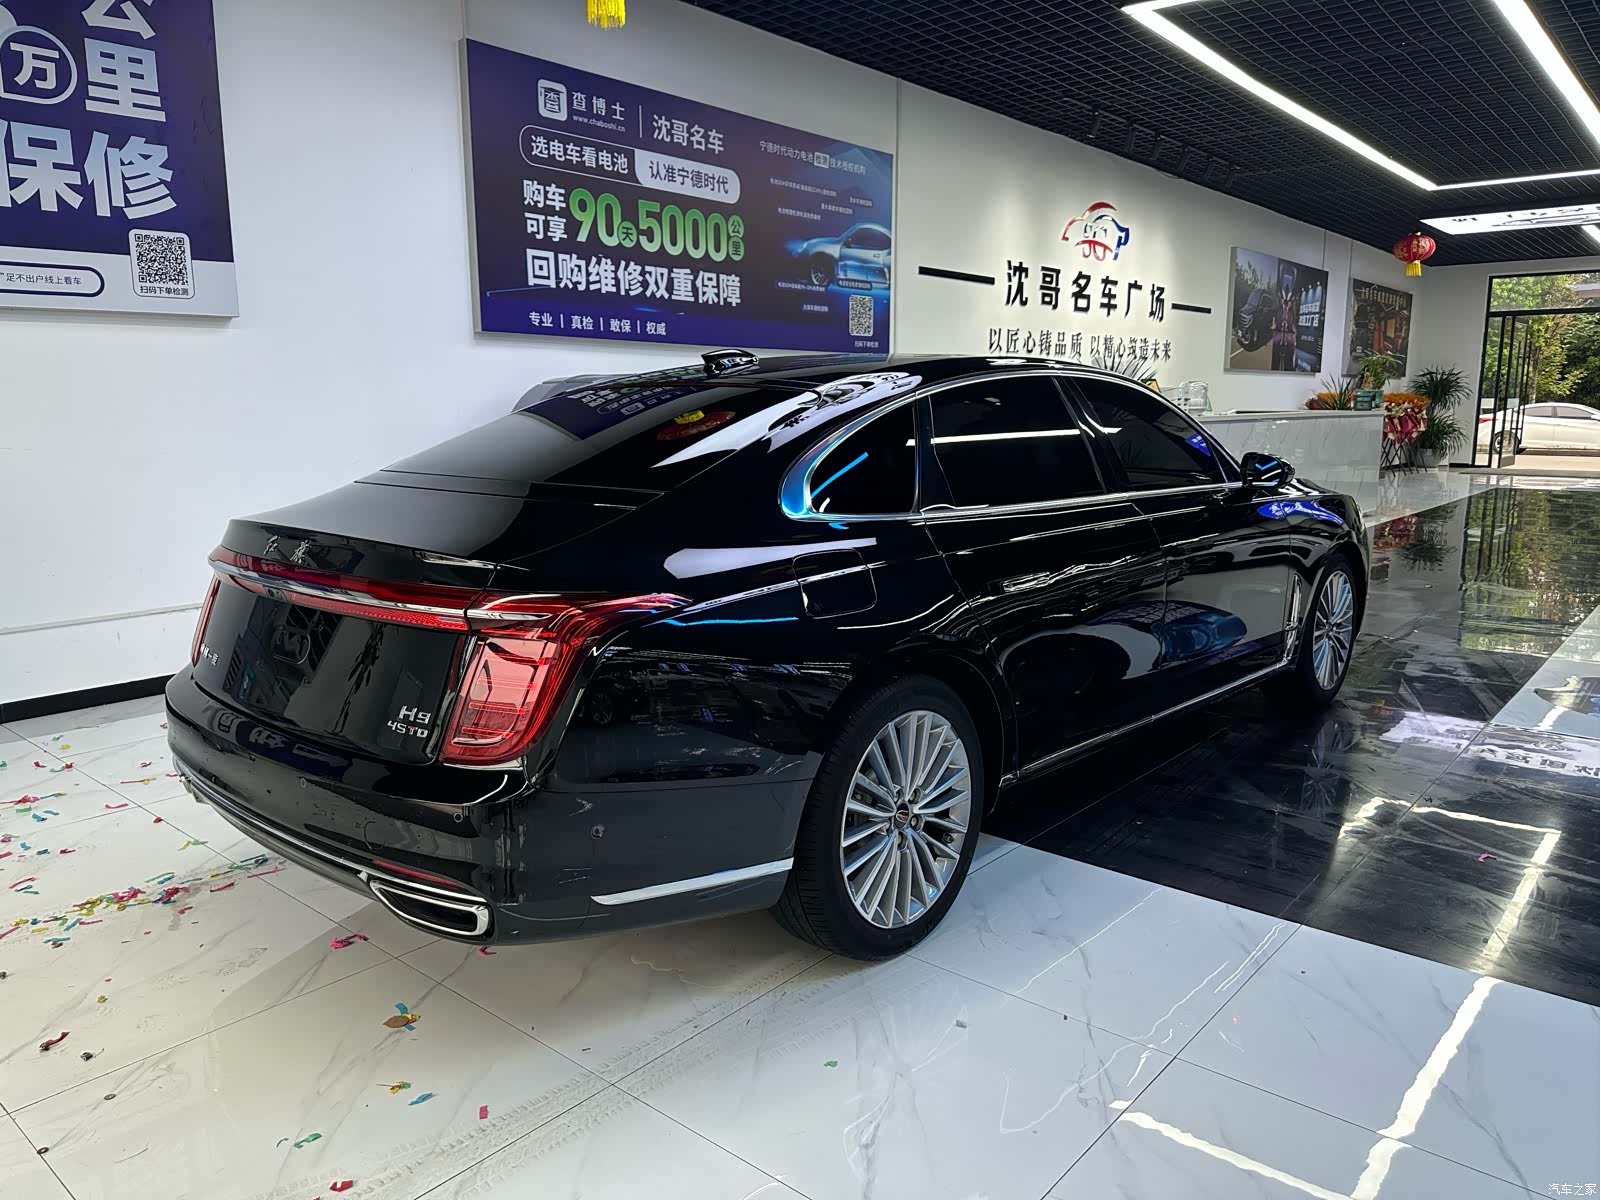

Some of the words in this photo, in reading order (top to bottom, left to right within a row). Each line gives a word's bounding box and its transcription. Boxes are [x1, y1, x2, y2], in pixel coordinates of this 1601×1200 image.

[9, 42, 60, 89] 万
[572, 91, 625, 120] 查博士
[572, 114, 626, 133] www.chaboshi.cn
[652, 114, 725, 154] 沈哥名车
[0, 119, 177, 220] 保修
[531, 135, 629, 174] 选电车看电池
[649, 161, 729, 195] 认准宁德时代
[523, 180, 567, 211] 购车
[524, 212, 568, 242] 可享
[6, 271, 82, 285] 足不出户线上看车
[140, 285, 189, 296] 扫码下单检测
[526, 248, 742, 307] 回购维修双重保障
[1005, 260, 1165, 322] 沈哥名车广场
[529, 312, 554, 327] 专业
[571, 315, 594, 330] 真检
[610, 319, 632, 333] 敢保
[646, 321, 667, 335] 权威
[989, 327, 1083, 358] 以匠心铸品质
[1090, 333, 1172, 361] 以精心筑造未来
[387, 720, 429, 738] 45TD
[398, 705, 432, 724] H9
